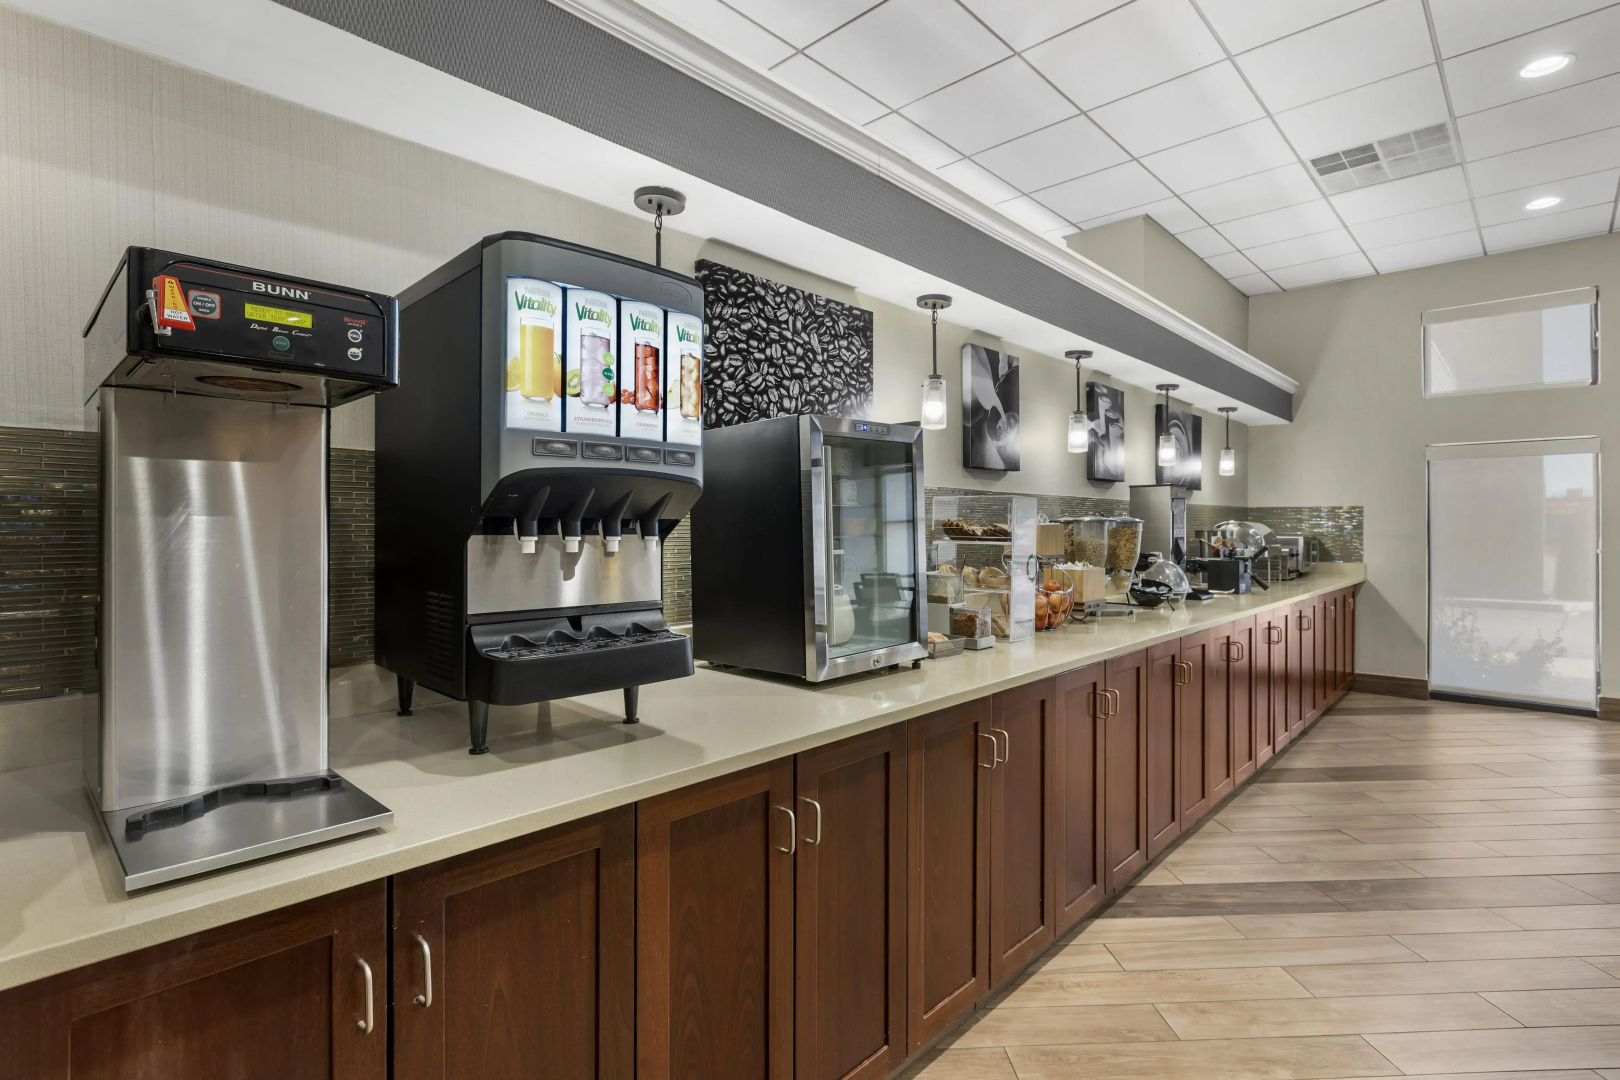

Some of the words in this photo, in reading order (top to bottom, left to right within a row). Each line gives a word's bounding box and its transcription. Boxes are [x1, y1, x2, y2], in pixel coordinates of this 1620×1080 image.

[168, 285, 178, 310] WARNING
[252, 281, 309, 301] BUNN
[250, 306, 271, 315] READY
[514, 290, 558, 317] Vitality
[166, 313, 188, 321] WATER
[246, 311, 267, 319] WATER
[575, 301, 613, 328] Vitality
[629, 312, 661, 338] Vitality
[573, 416, 606, 424] STRAWBERRY
